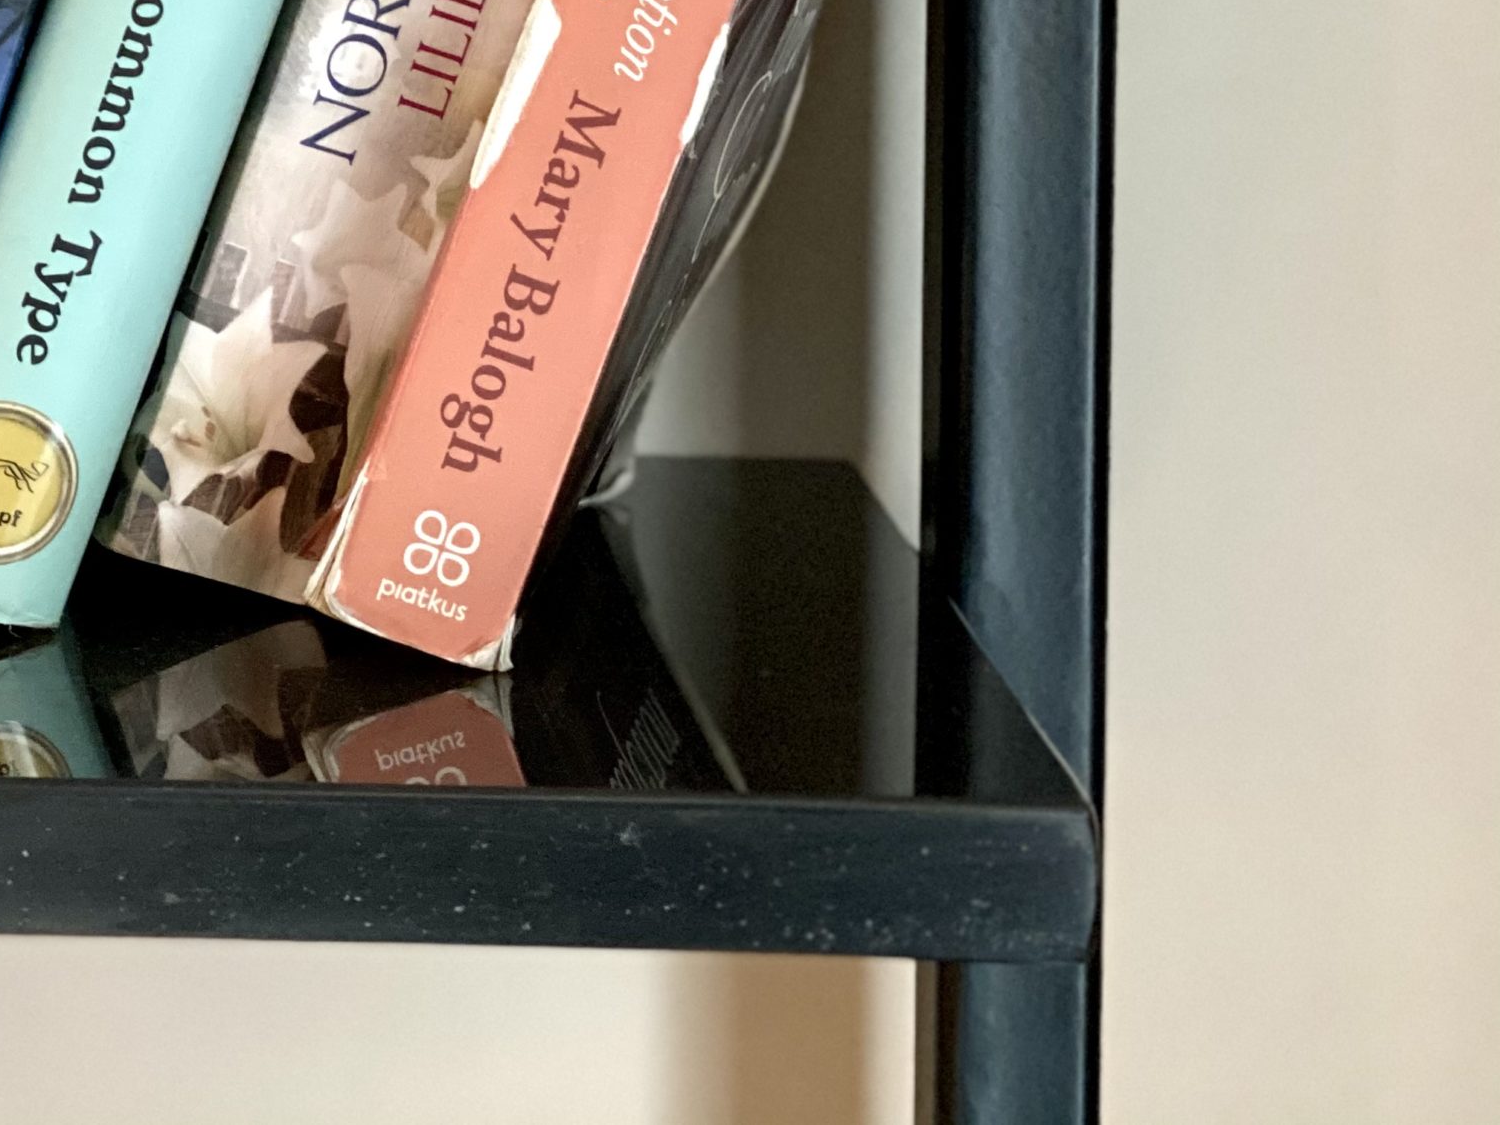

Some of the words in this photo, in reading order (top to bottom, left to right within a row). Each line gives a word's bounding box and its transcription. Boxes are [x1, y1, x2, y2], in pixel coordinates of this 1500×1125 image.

[510, 89, 622, 261] Mary
[16, 230, 104, 365] Type
[440, 263, 560, 473] Balogh
[376, 577, 468, 622] piatkus
